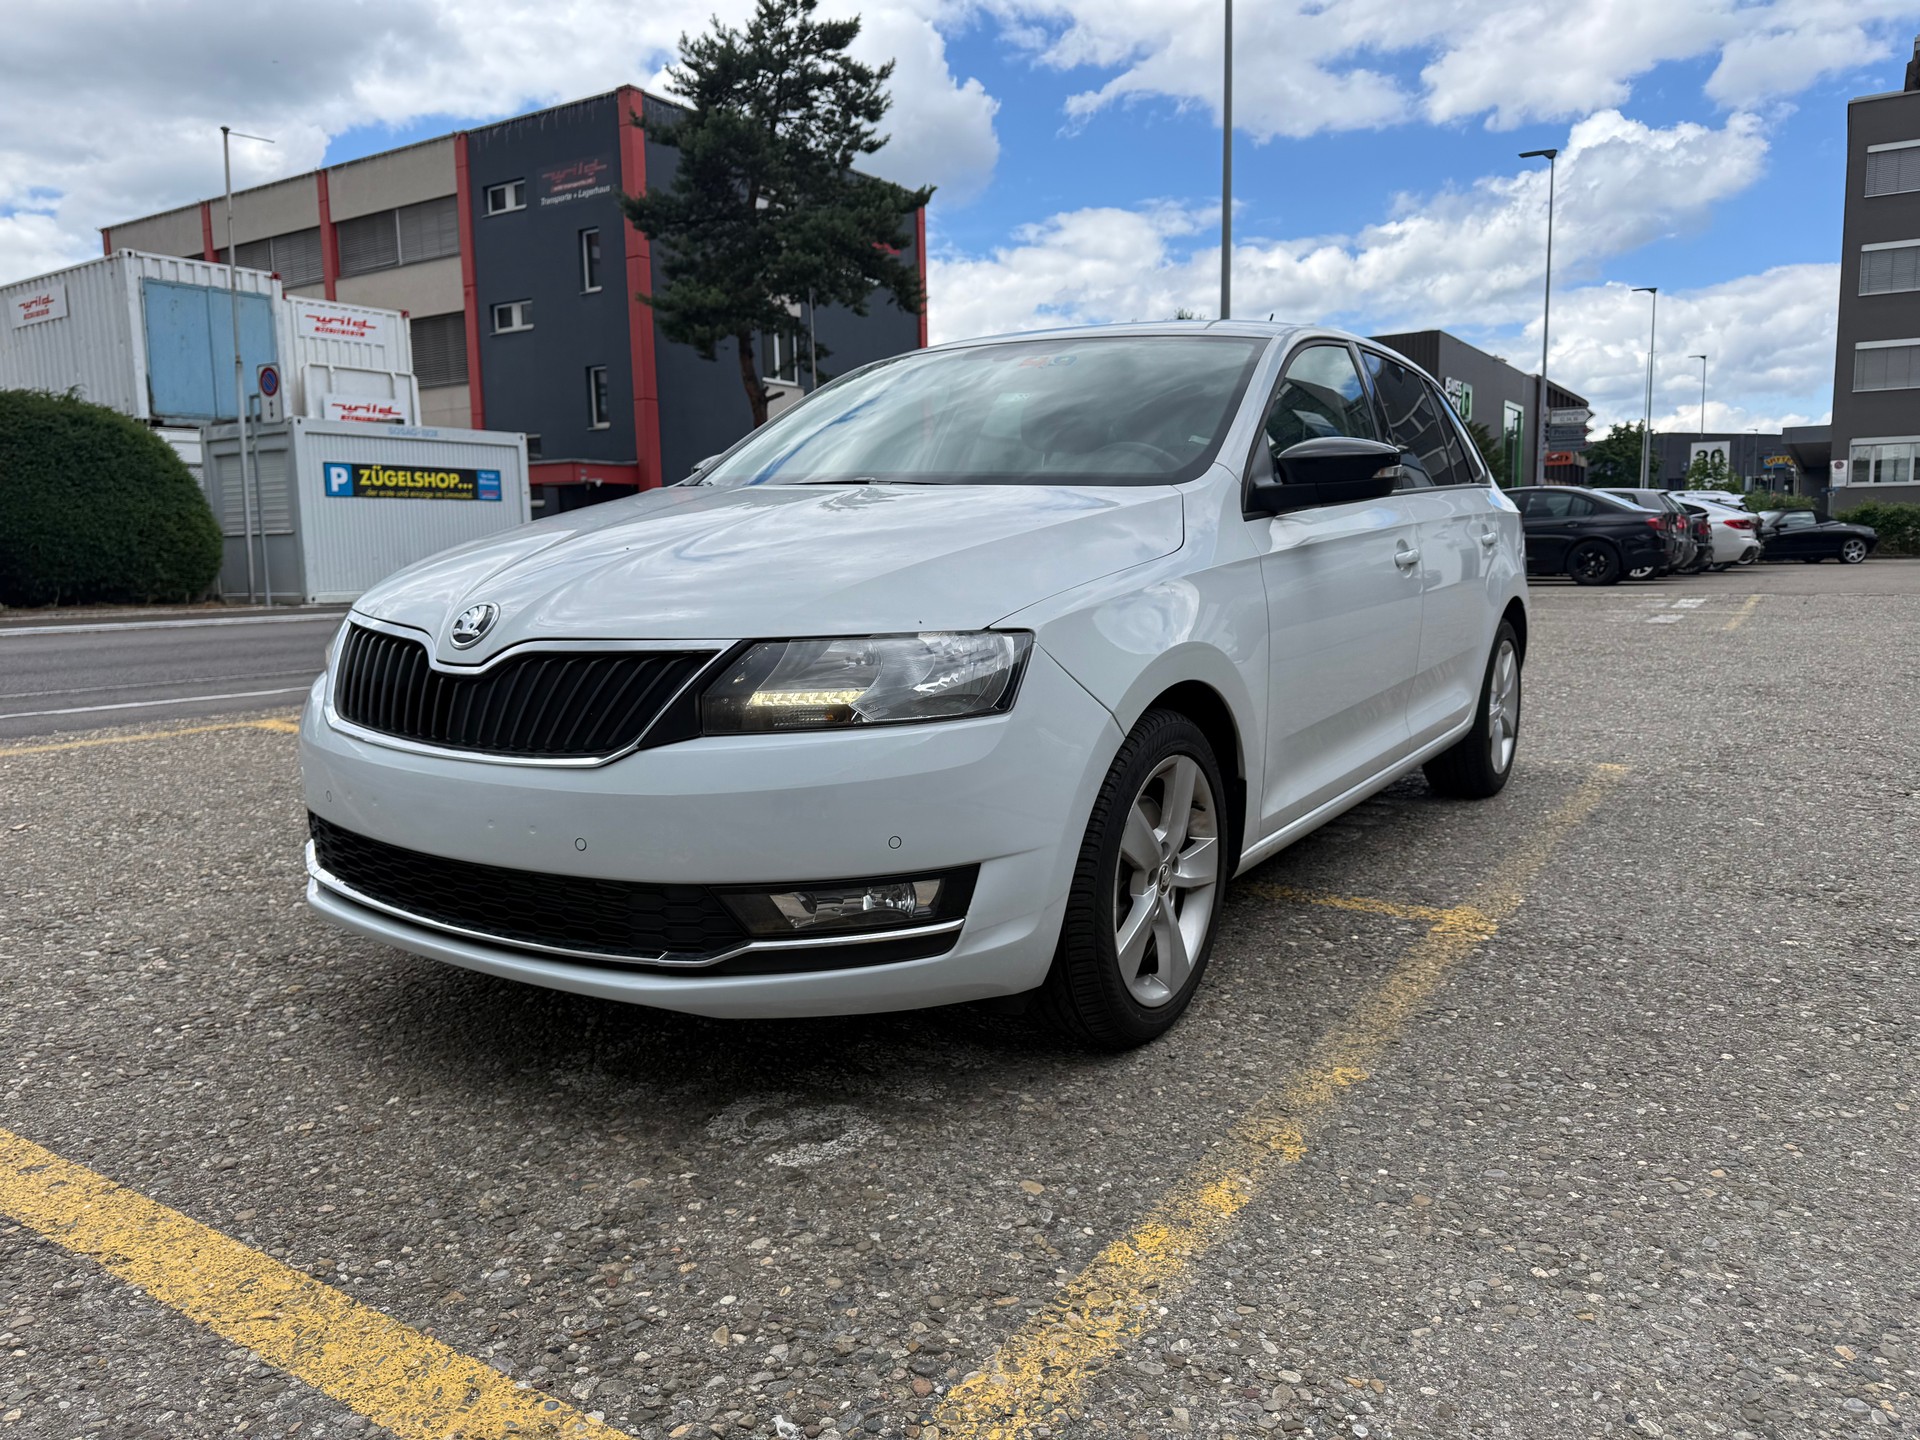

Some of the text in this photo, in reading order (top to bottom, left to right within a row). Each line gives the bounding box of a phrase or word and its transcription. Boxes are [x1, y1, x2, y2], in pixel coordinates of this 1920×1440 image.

[540, 193, 572, 206] Transporte
[578, 185, 611, 199] Lagerhaus
[305, 314, 376, 330] wild
[331, 403, 401, 417] wild
[329, 466, 349, 493] P
[358, 464, 473, 489] ZÜGELSHOP...
